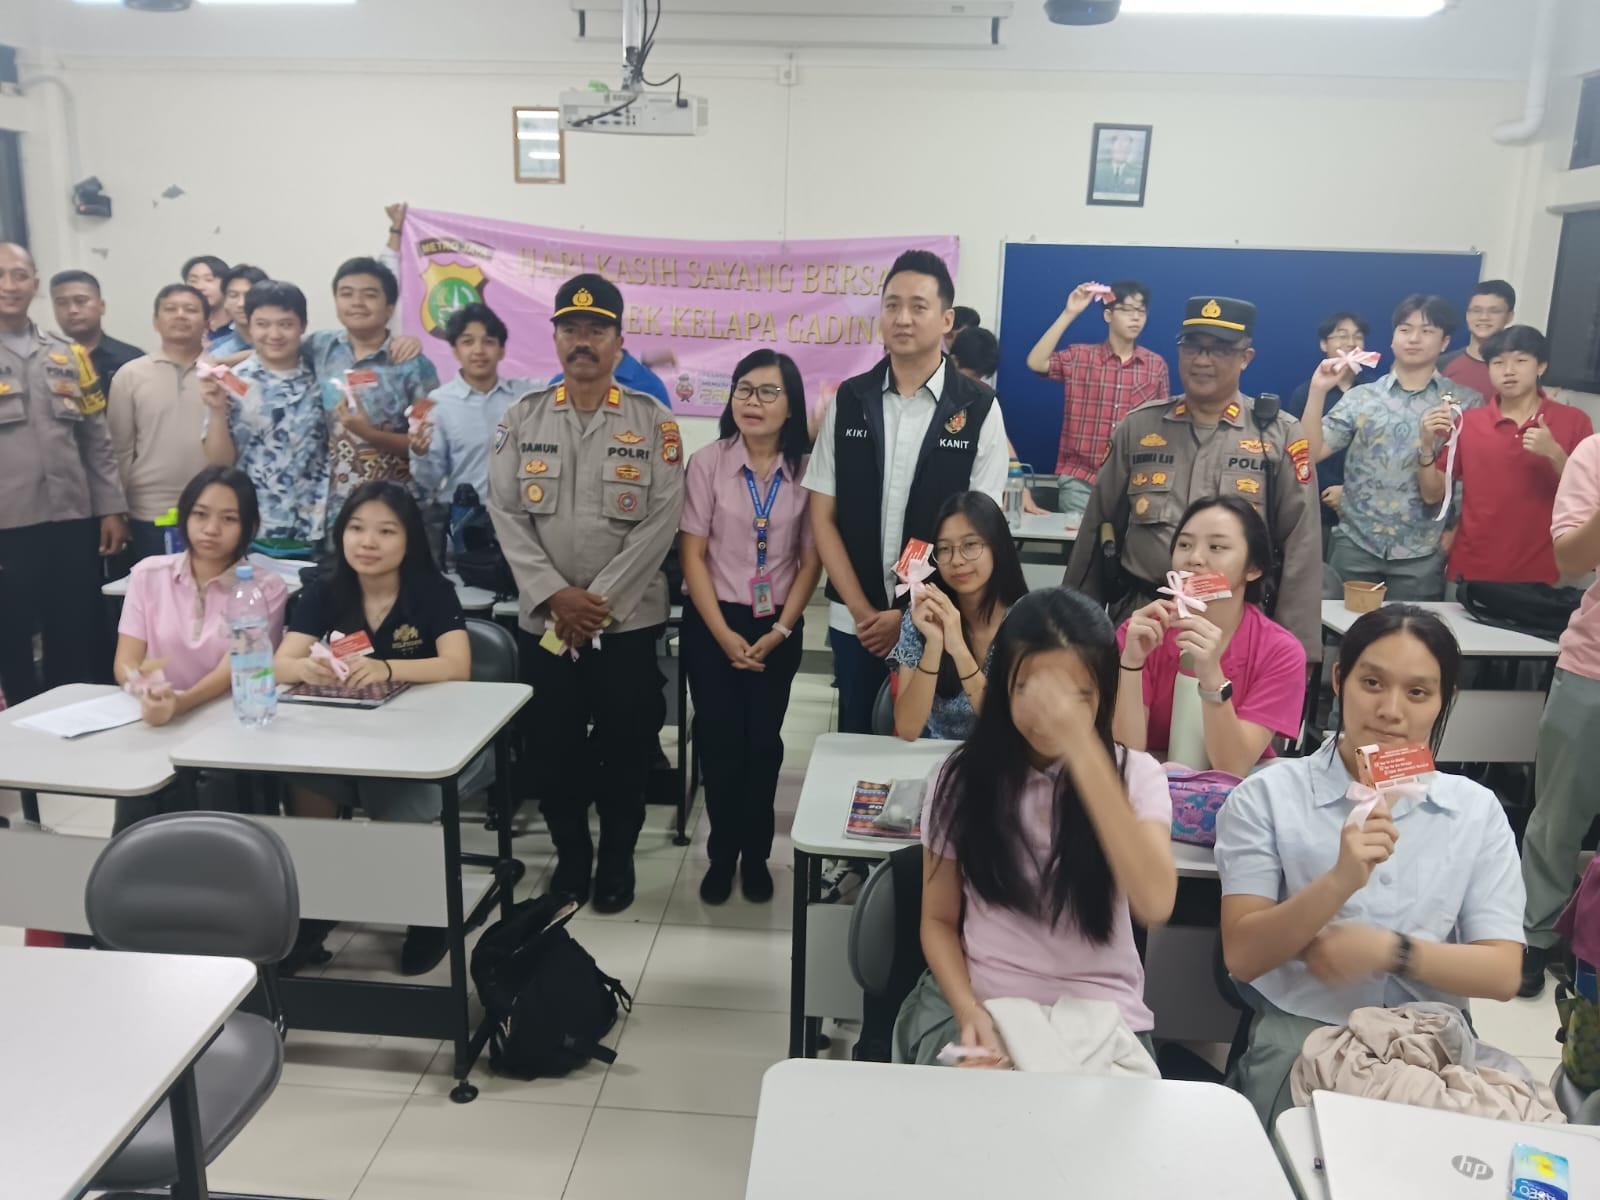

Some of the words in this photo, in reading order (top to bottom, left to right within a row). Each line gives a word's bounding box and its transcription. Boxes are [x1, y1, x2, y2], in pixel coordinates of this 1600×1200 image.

[518, 247, 585, 278] HARI
[594, 254, 679, 287] KASIH
[687, 260, 793, 293] SAYANG
[670, 305, 777, 342] KELAPA
[845, 428, 867, 438] KIKI
[939, 438, 970, 449] KANIT
[608, 447, 650, 460] POLRI
[1457, 1155, 1490, 1180] hp
